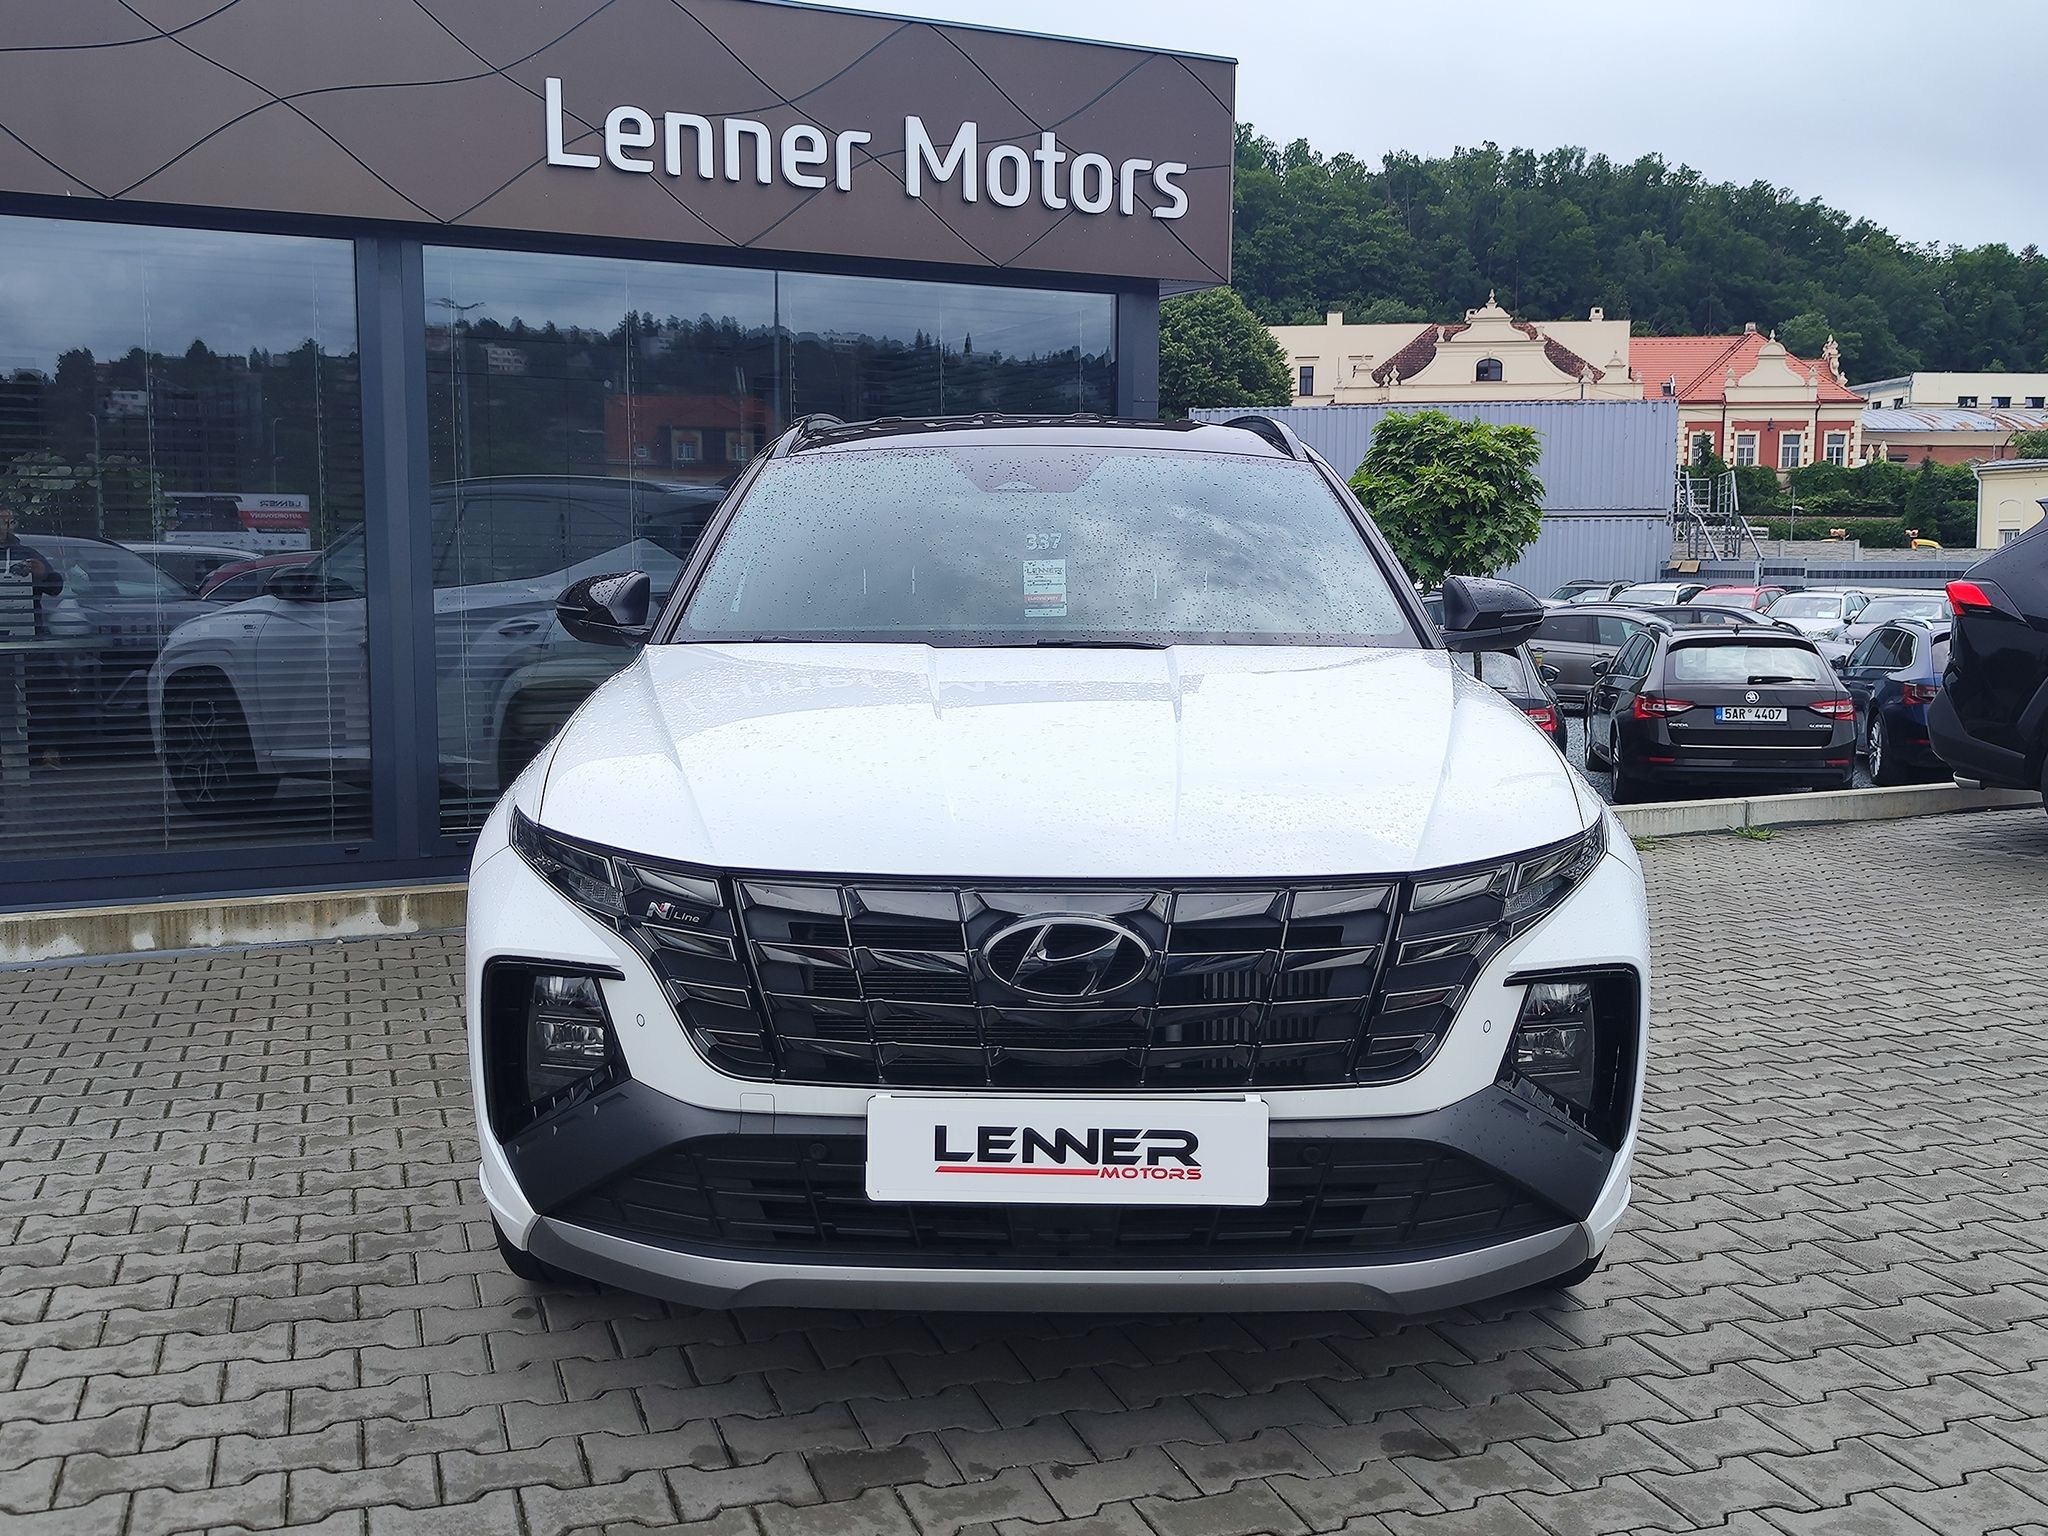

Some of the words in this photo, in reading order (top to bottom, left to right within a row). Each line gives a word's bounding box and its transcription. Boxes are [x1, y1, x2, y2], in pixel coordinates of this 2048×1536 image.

[545, 76, 872, 192] Lenner
[905, 115, 1189, 219] Motors
[1724, 708, 1746, 720] 5AR
[1754, 709, 1782, 720] 4407
[673, 910, 700, 923] Line
[934, 1124, 1202, 1167] LENNER
[1100, 1166, 1202, 1181] MOTORS
